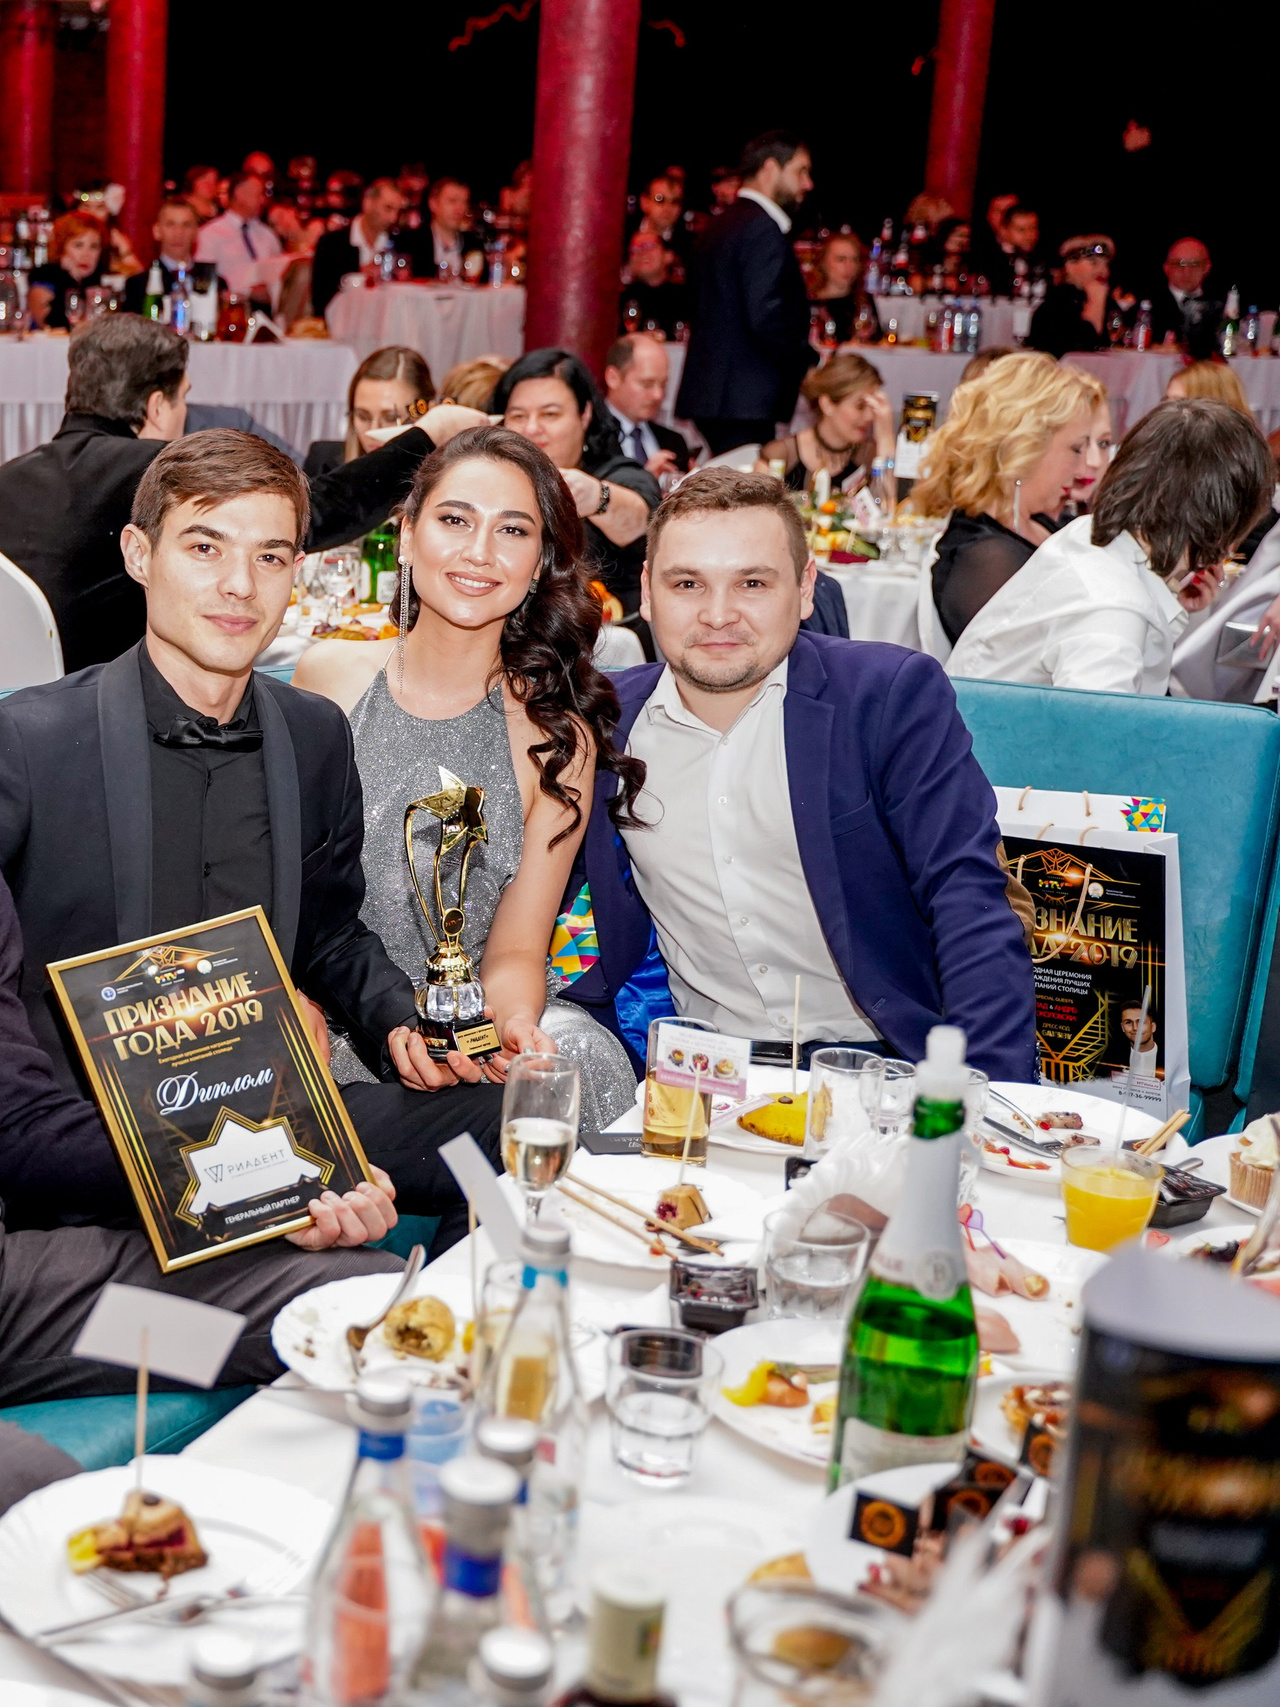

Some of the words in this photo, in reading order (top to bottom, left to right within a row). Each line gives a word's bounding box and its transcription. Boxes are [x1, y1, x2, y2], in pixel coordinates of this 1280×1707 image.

[1070, 941, 1139, 969] 2019
[1054, 969, 1093, 980] ЦЕРЕМОНИЯ
[1064, 978, 1091, 988] ЛУЧШИХ
[103, 972, 256, 1035] ПРИЗНАНИЕ
[1057, 985, 1088, 995] СТОЛИЦЫ
[113, 1019, 197, 1061] ГОДА
[200, 999, 264, 1037] 2019
[156, 1067, 274, 1116] Диплом
[225, 1203, 272, 1225] ГЕНЕРАЛЬНЫЙ
[271, 1195, 301, 1213] ПАРТНЕР
